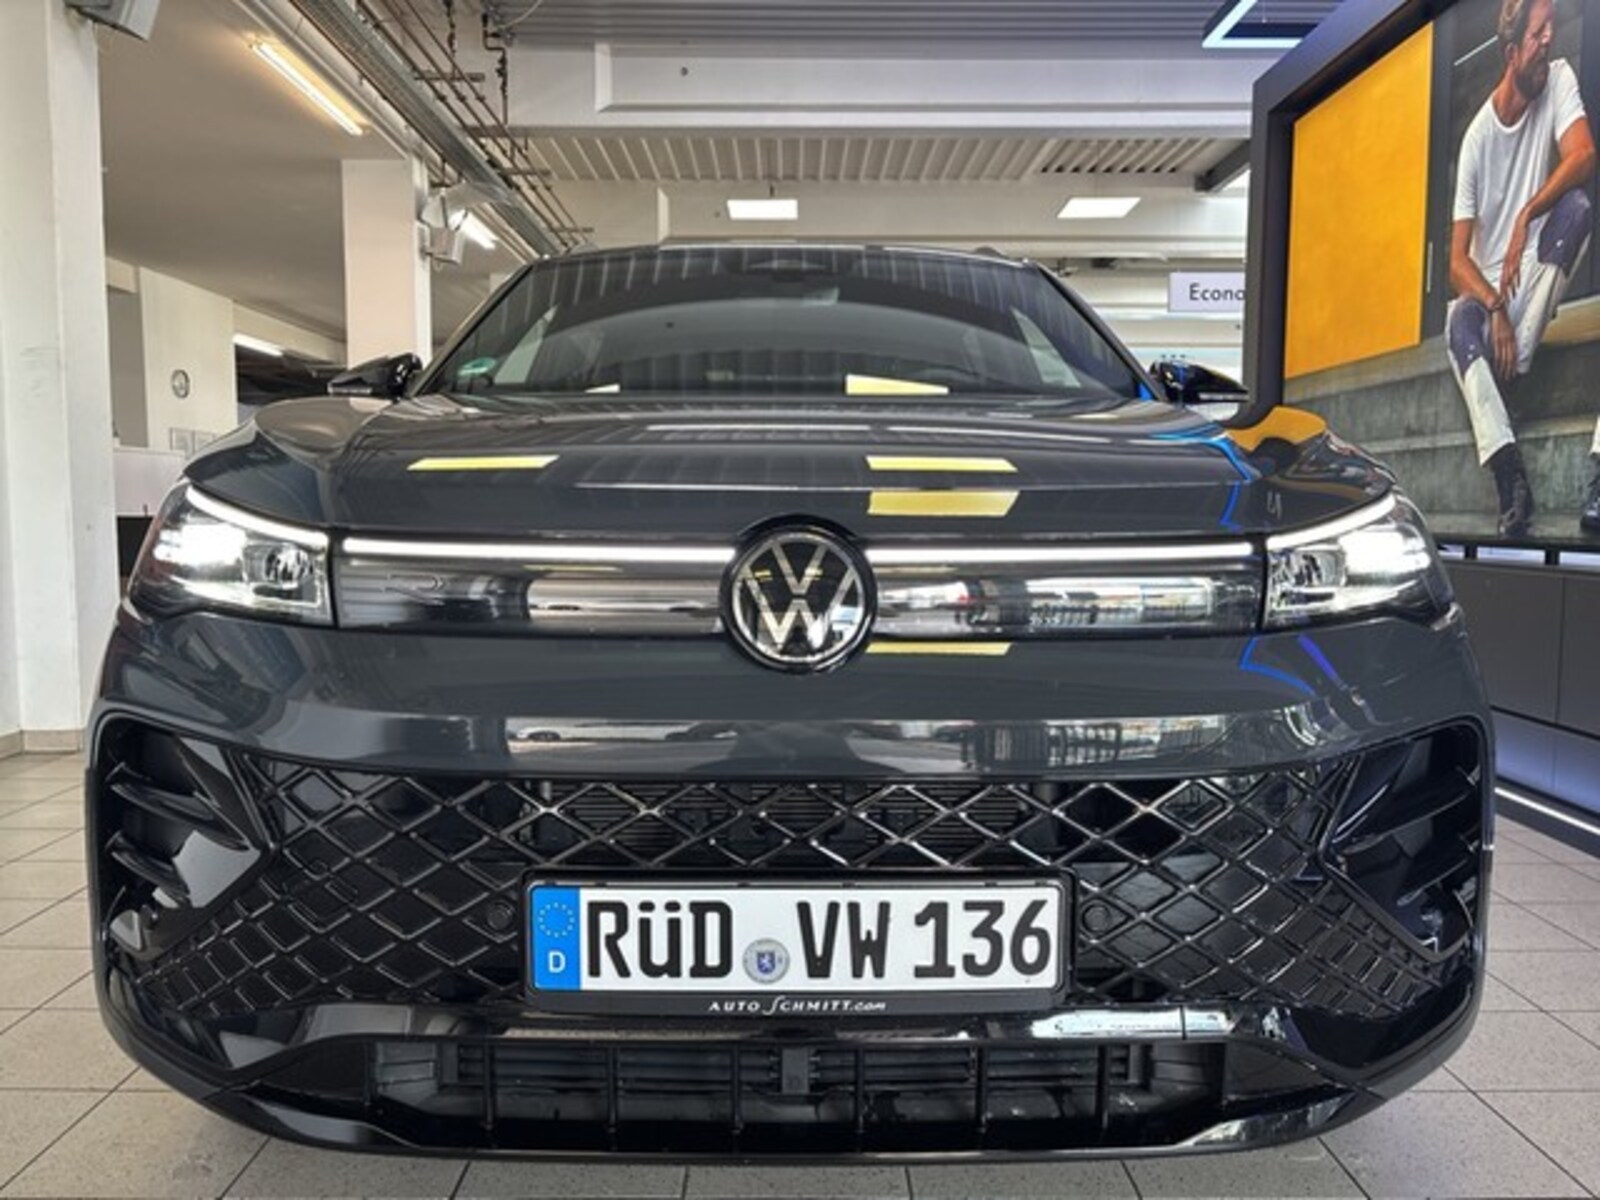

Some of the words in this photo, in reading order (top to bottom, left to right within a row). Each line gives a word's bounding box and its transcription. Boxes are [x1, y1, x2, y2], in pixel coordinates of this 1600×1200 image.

[734, 536, 864, 656] VW
[548, 951, 567, 974] D
[796, 900, 891, 979] VW
[913, 899, 1051, 979] 136
[708, 1001, 761, 1012] AUTO
